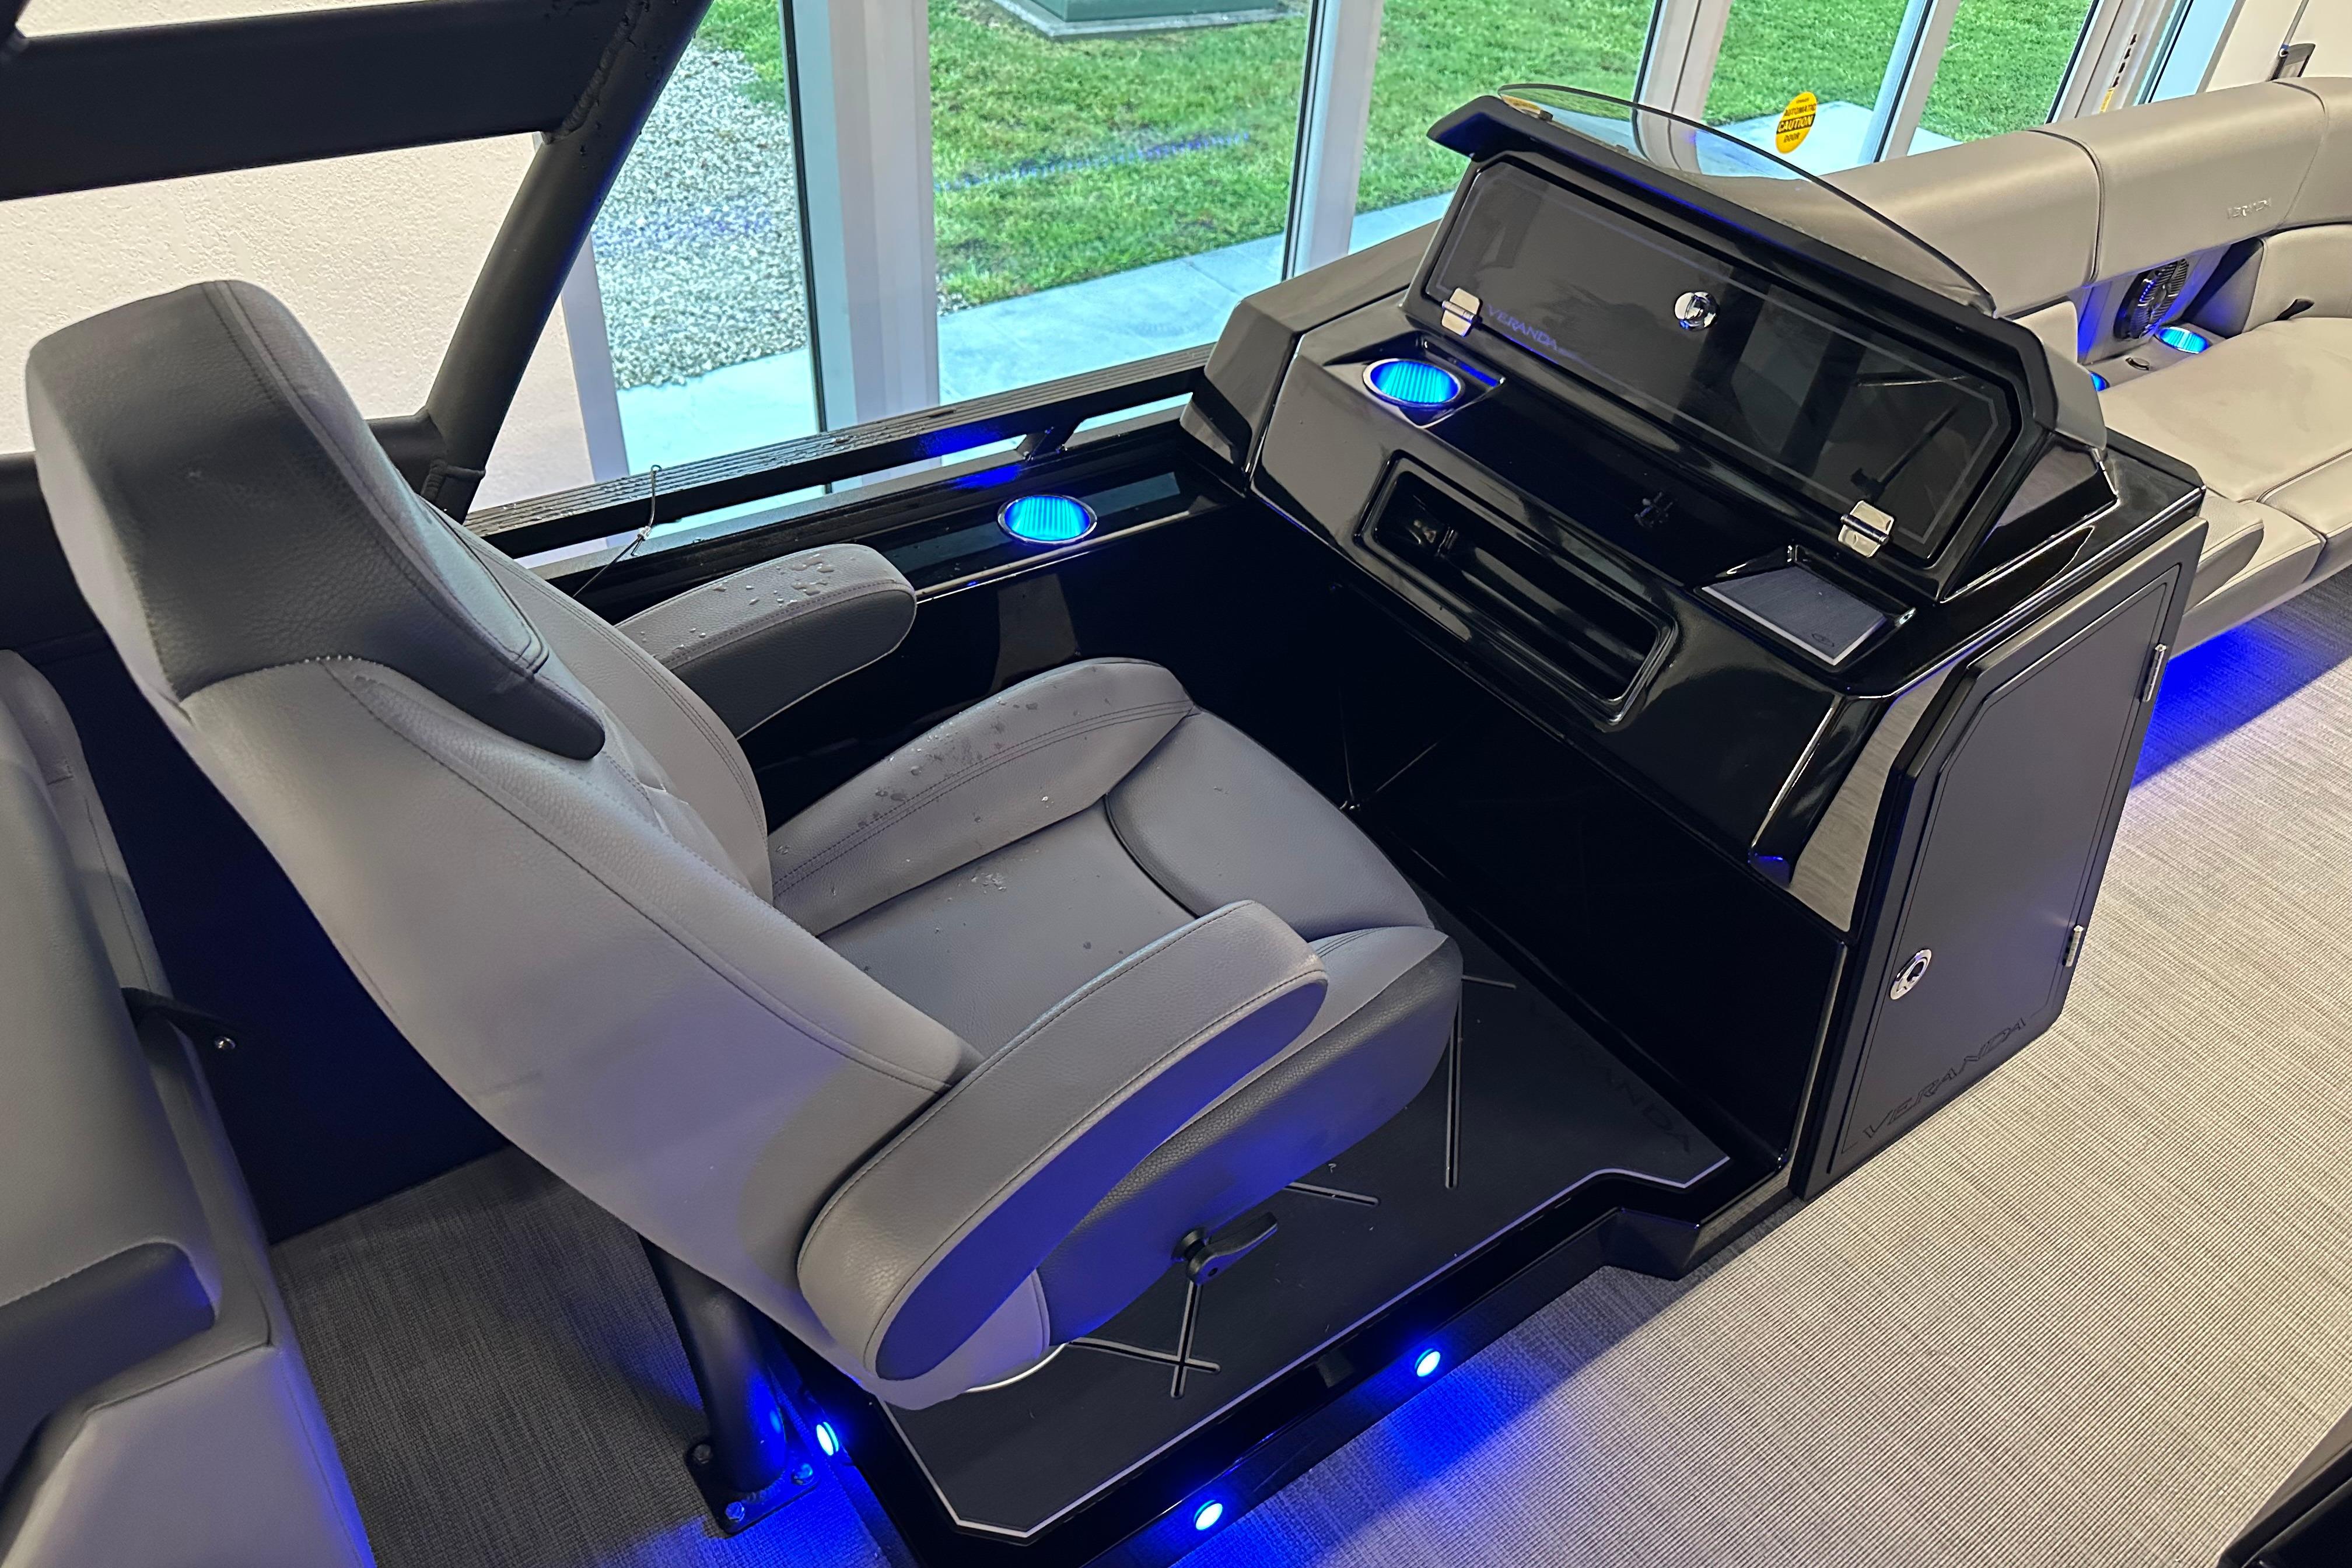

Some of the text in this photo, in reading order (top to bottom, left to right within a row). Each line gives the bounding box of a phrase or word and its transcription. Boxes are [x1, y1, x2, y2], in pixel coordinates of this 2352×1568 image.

[1778, 116, 1813, 132] CAUTION
[1487, 304, 1557, 350] VERANDA
[1863, 1017, 2025, 1138] VERANDA
